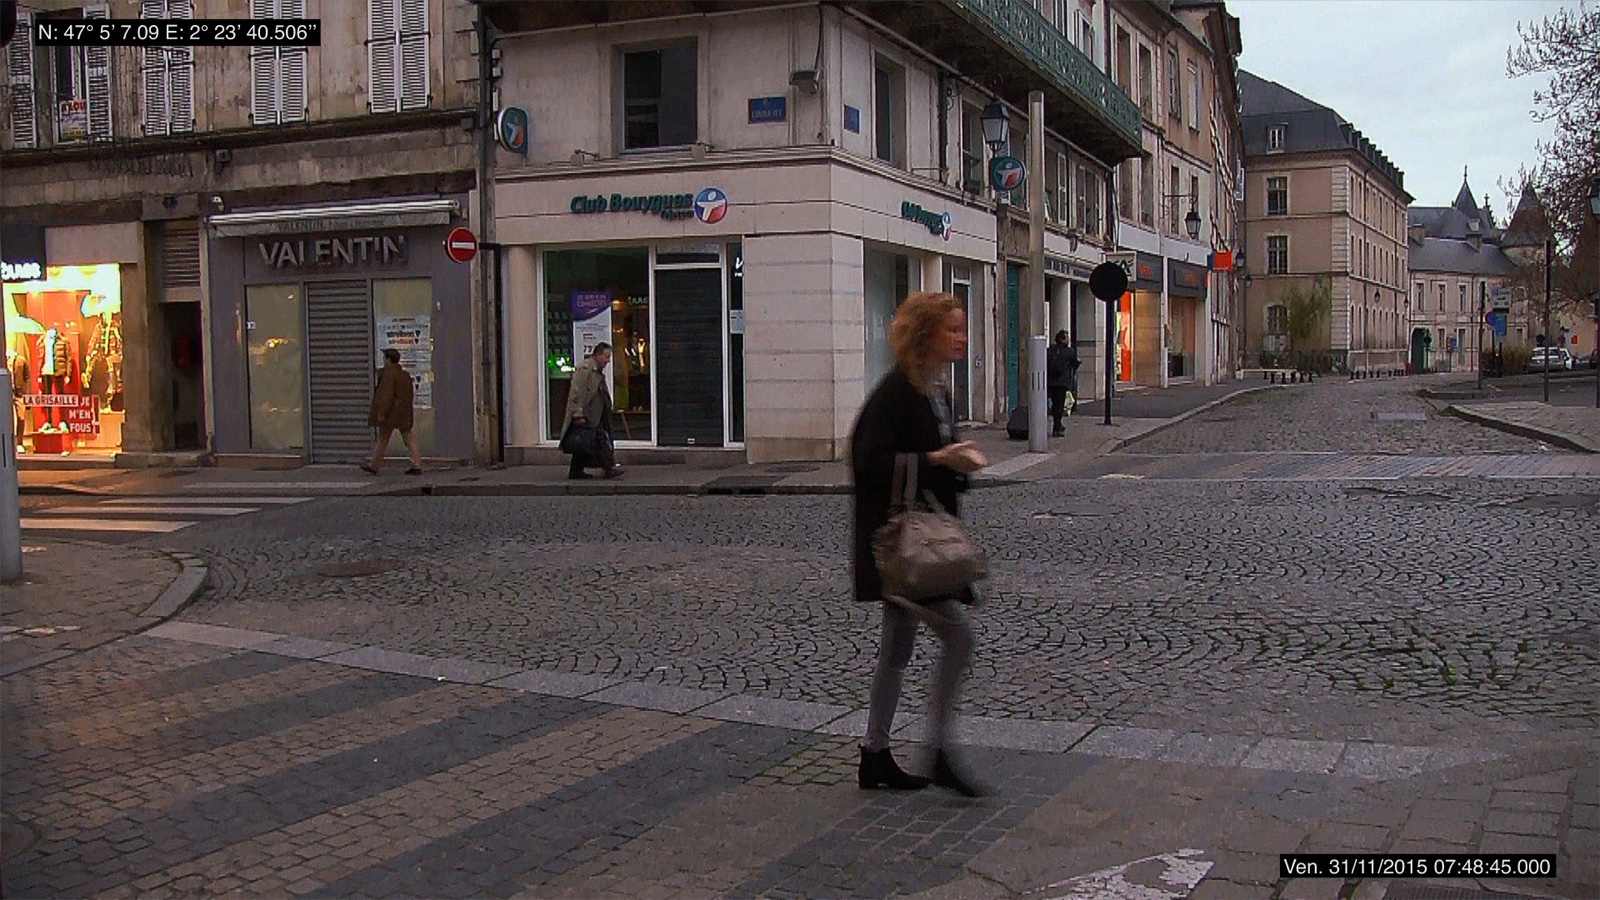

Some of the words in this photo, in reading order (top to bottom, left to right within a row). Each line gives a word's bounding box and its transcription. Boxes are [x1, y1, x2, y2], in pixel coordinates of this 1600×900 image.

[570, 195, 607, 213] Club
[609, 193, 695, 215] Bouygues
[258, 235, 405, 268] VALENTIN
[23, 396, 35, 406] LA
[36, 395, 77, 406] GRISAILLE
[69, 422, 92, 433] FOUS
